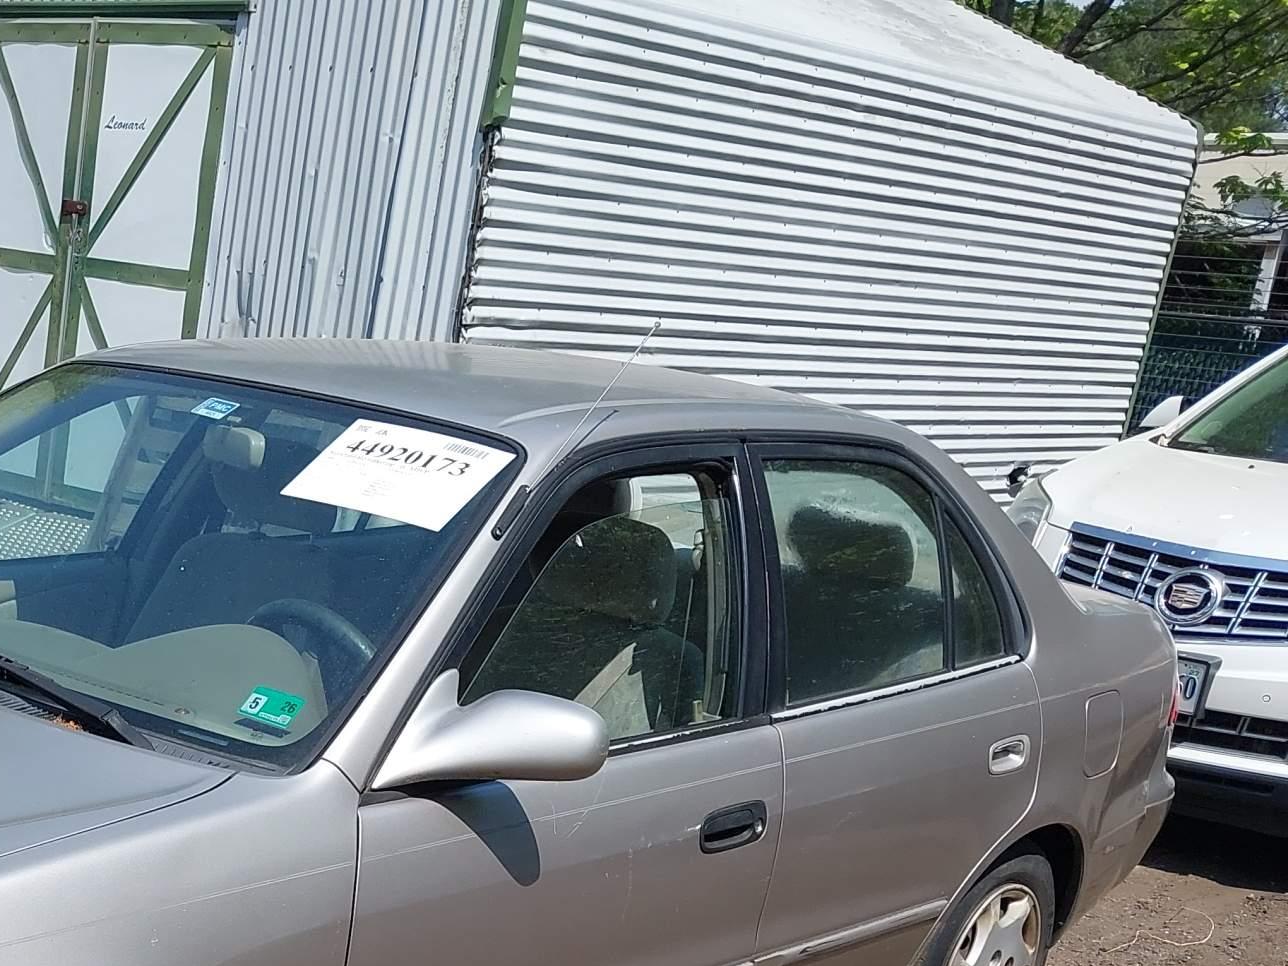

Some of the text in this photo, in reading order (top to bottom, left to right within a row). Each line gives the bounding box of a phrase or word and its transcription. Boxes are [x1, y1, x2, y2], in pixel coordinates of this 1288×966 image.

[104, 115, 147, 130] Leonard
[346, 439, 471, 477] 44920173
[249, 696, 298, 714] 5 26
